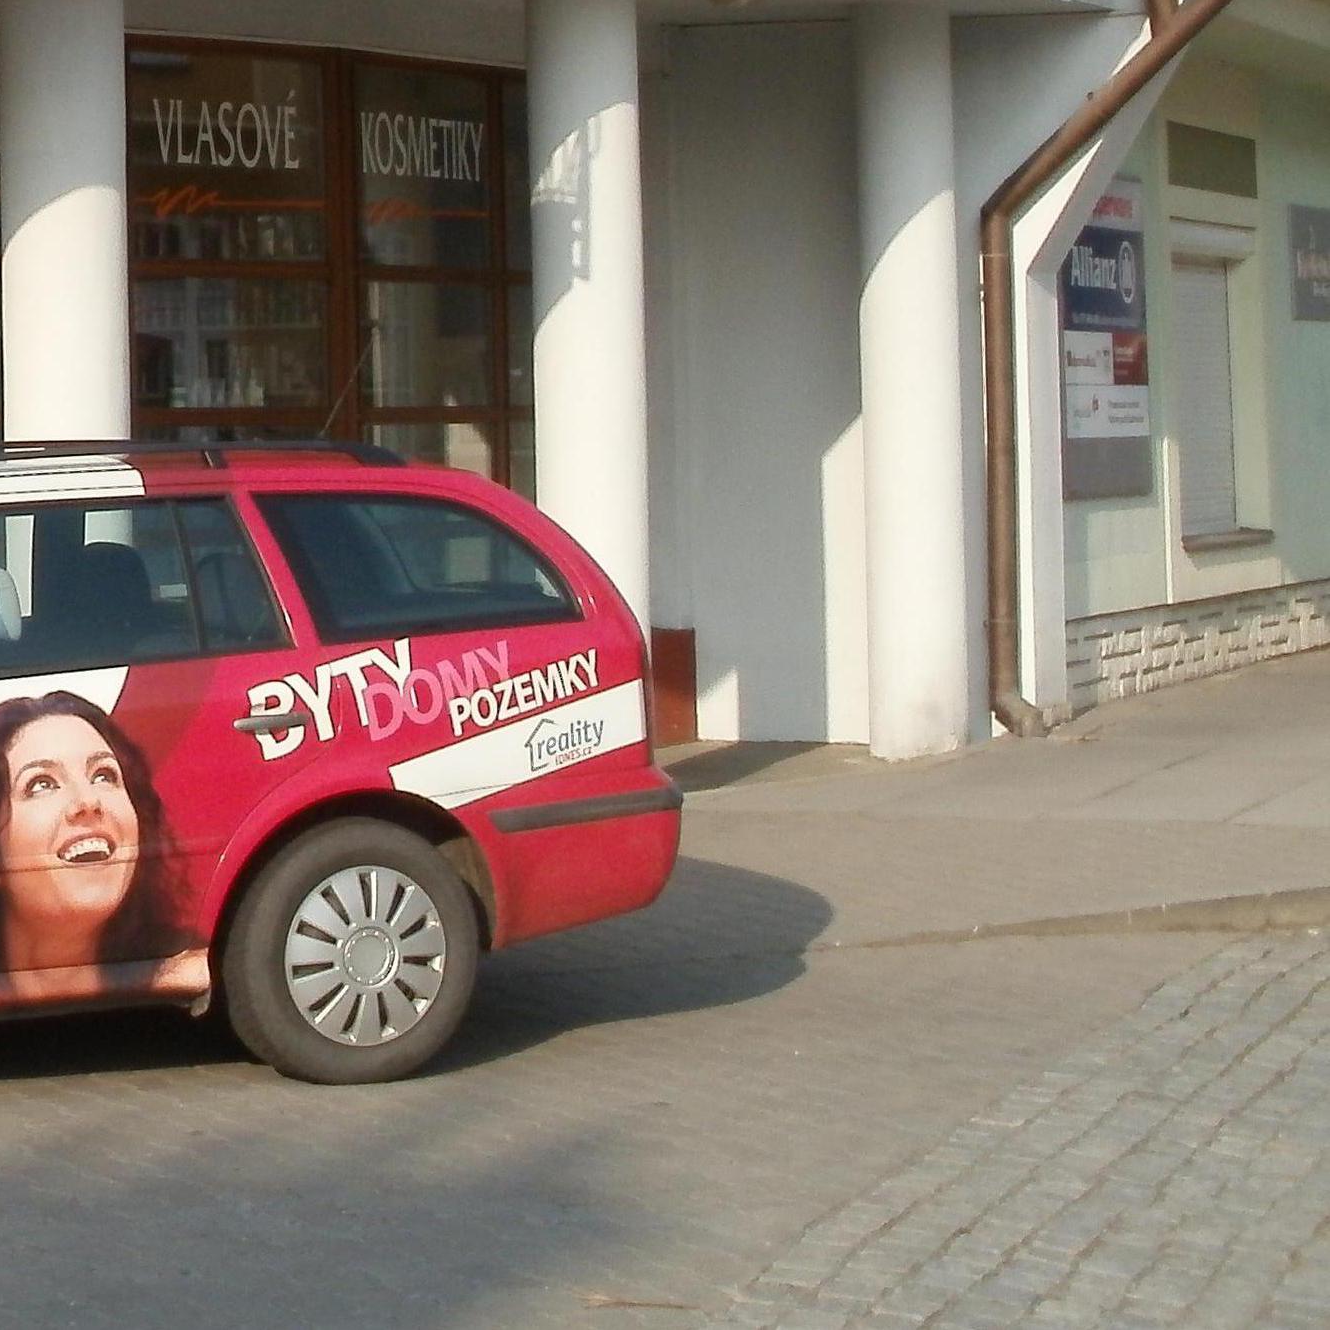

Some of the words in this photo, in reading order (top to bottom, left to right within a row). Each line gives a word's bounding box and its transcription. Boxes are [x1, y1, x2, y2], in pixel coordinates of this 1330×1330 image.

[152, 90, 301, 170] VLASOVÉ
[360, 110, 485, 182] KOSMETIKY
[246, 637, 418, 762] BYTY
[363, 640, 511, 742] DOMY
[449, 648, 598, 738] POZEMKY
[536, 719, 604, 760] reality
